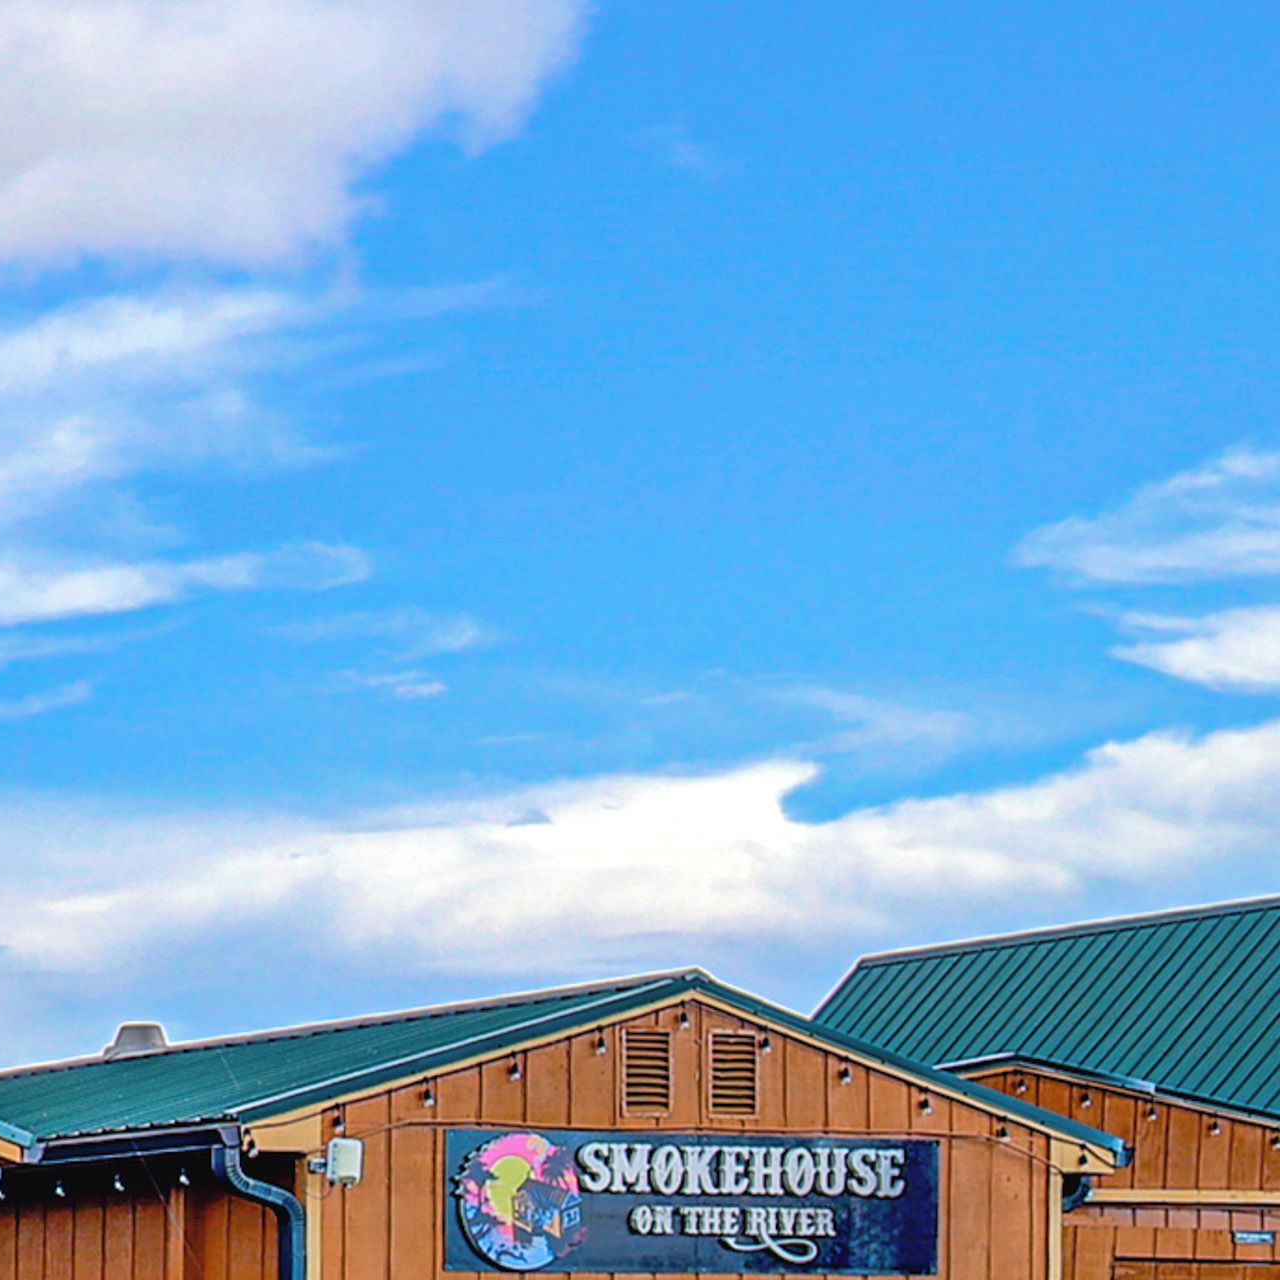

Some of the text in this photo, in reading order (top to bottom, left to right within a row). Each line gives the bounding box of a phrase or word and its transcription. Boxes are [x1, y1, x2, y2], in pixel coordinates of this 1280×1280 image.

[579, 1142, 904, 1197] SMOKEHOUSE
[631, 1206, 673, 1235] ON
[681, 1207, 739, 1236] THE
